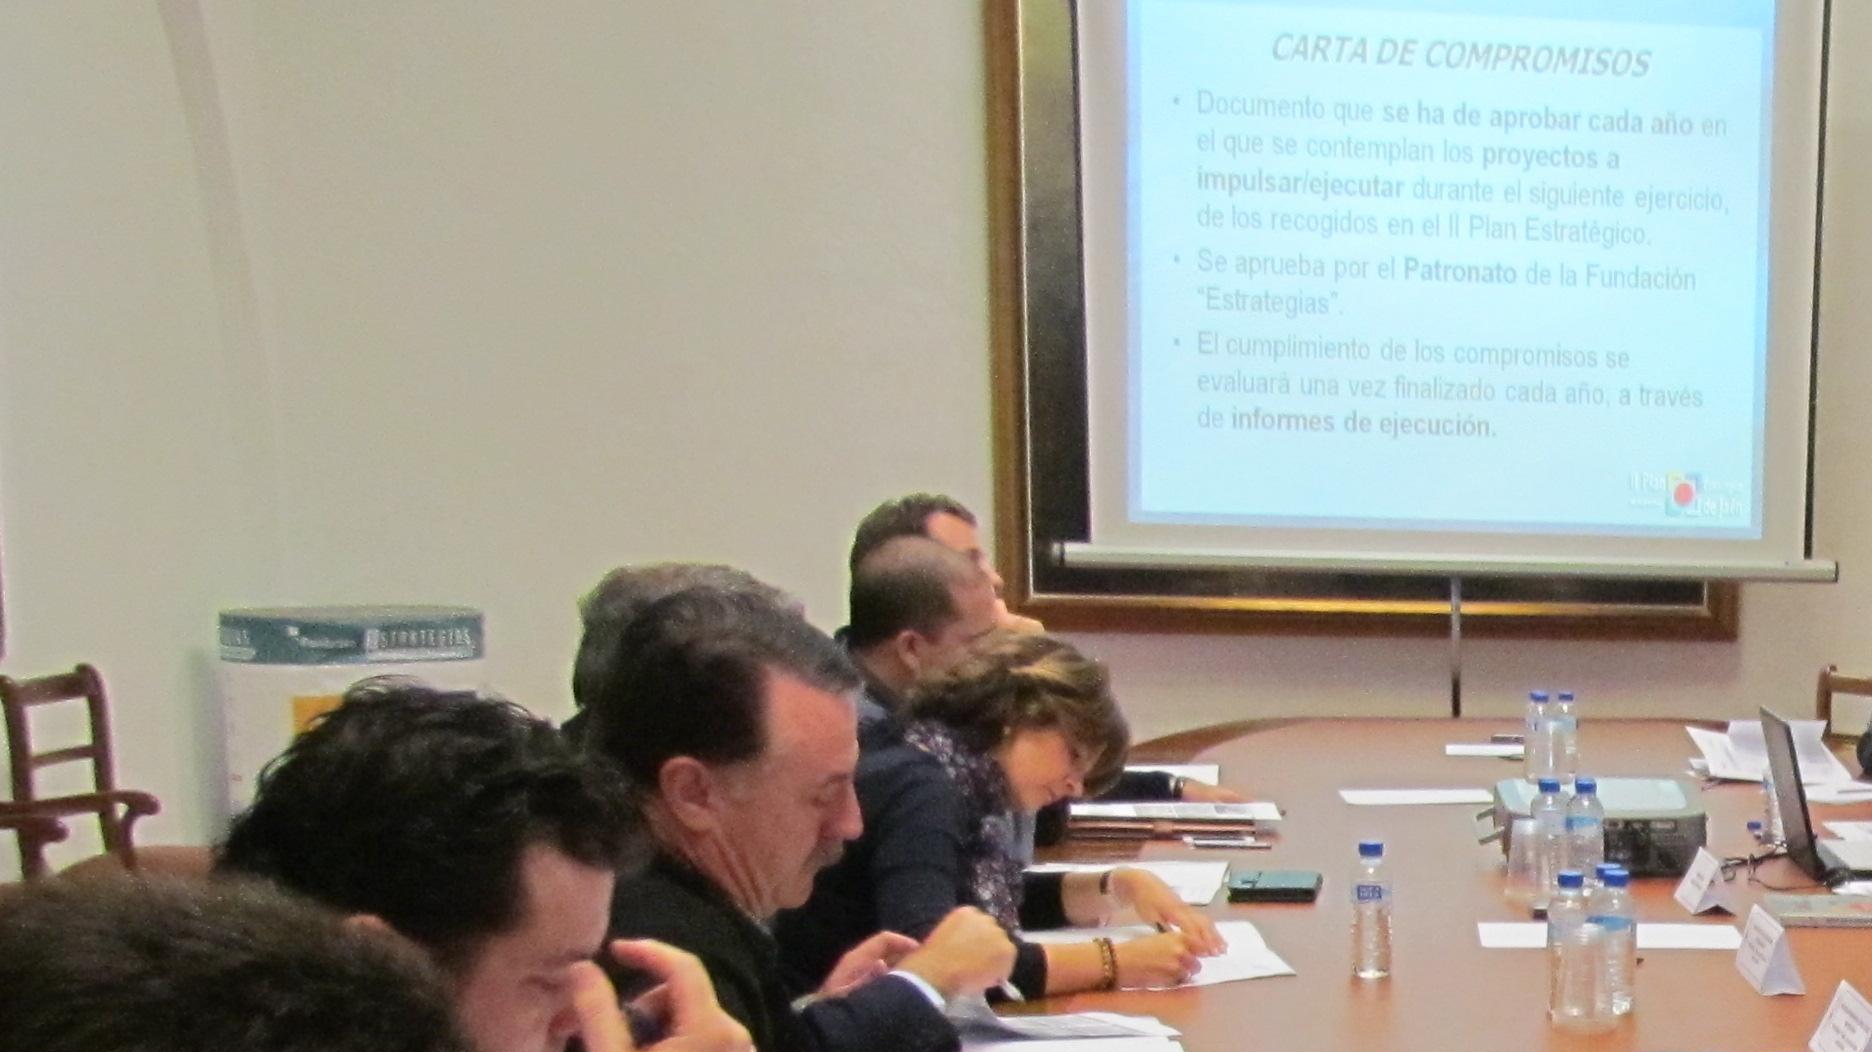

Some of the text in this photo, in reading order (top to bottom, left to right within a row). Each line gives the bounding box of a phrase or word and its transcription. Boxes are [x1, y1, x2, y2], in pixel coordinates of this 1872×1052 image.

[1272, 32, 1653, 78] CARTA DE COMPROMISOS
[1197, 88, 1728, 138] Documento que se ha de aprobar cada año en
[1196, 128, 1621, 172] el que se contemplan los proyectos a
[1197, 164, 1729, 216] impulsar/ejecutar durante el siguiente ejercicio,
[1197, 202, 1652, 250] de los recogidos en el II Plan Estratégico.
[1197, 247, 1697, 291] Se aprueba por el Patronato de la Fundación
[1197, 329, 1631, 371] El cumplimiento de los compromisos se
[1197, 368, 1704, 409] evaluará una vez finalizado cada año, a través
[1197, 404, 1497, 440] de informes de ejecución.
